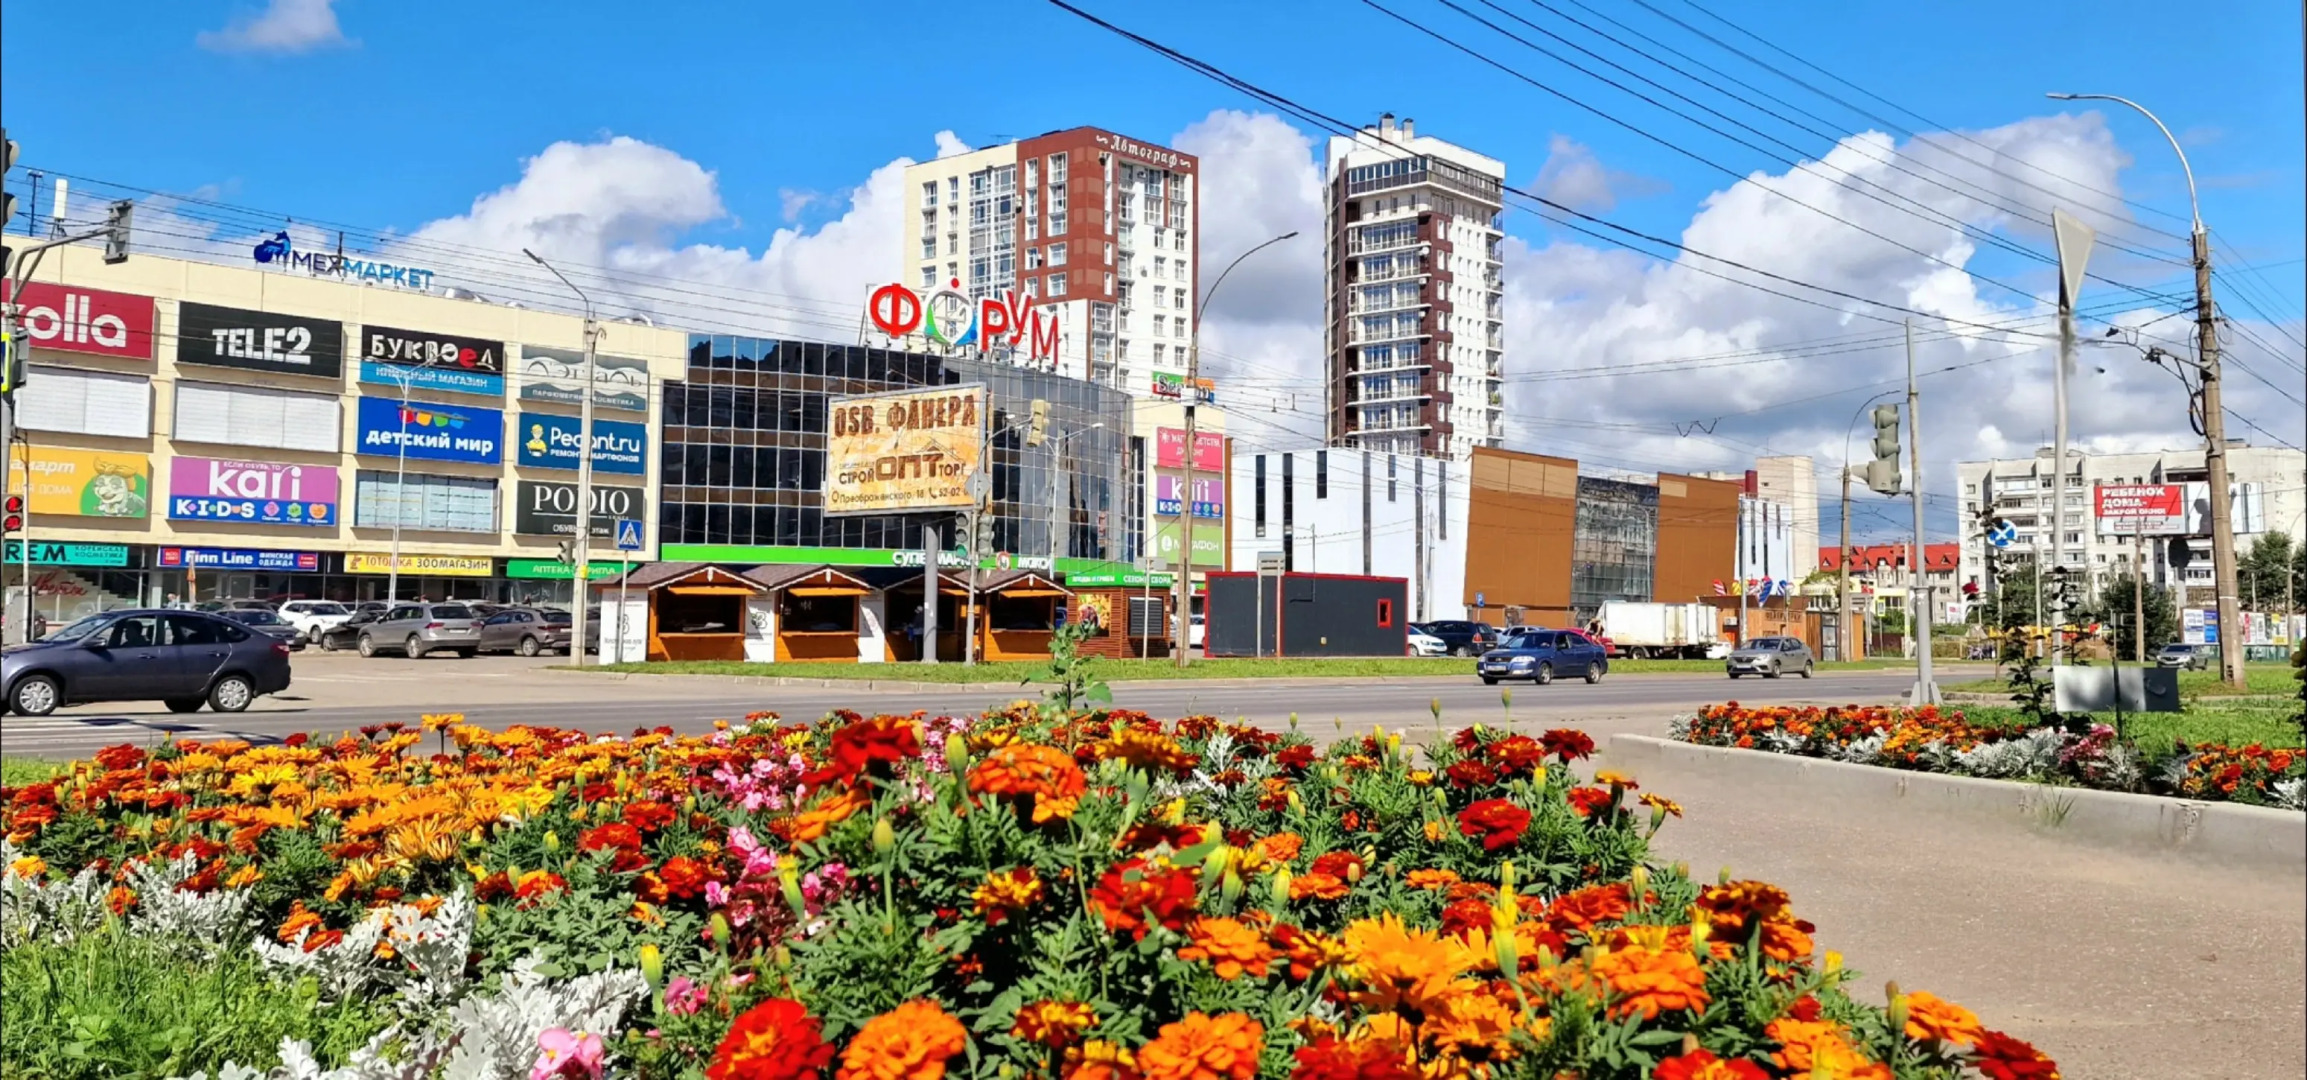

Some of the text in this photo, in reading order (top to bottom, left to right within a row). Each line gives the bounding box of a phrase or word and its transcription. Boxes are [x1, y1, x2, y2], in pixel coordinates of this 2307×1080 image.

[1111, 135, 1177, 168] Автограф
[869, 276, 1059, 366] ФОРУМ
[212, 326, 311, 365] TELE2
[438, 373, 488, 388] МАГАЗИН
[886, 394, 976, 432] ФАНЕРА
[366, 430, 494, 456] детский мир
[591, 452, 640, 463] МАРТФОНОВ
[209, 460, 302, 501] kari
[2102, 487, 2165, 498] РЕБЕНОК
[185, 550, 218, 564] Finn
[222, 551, 254, 565] Line
[259, 552, 294, 560] ФИНСКАЯ
[259, 559, 294, 567] ОДЕЖДА
[417, 559, 489, 570] ЗООМАГАЗИН
[533, 564, 570, 575] АПТЕКА
